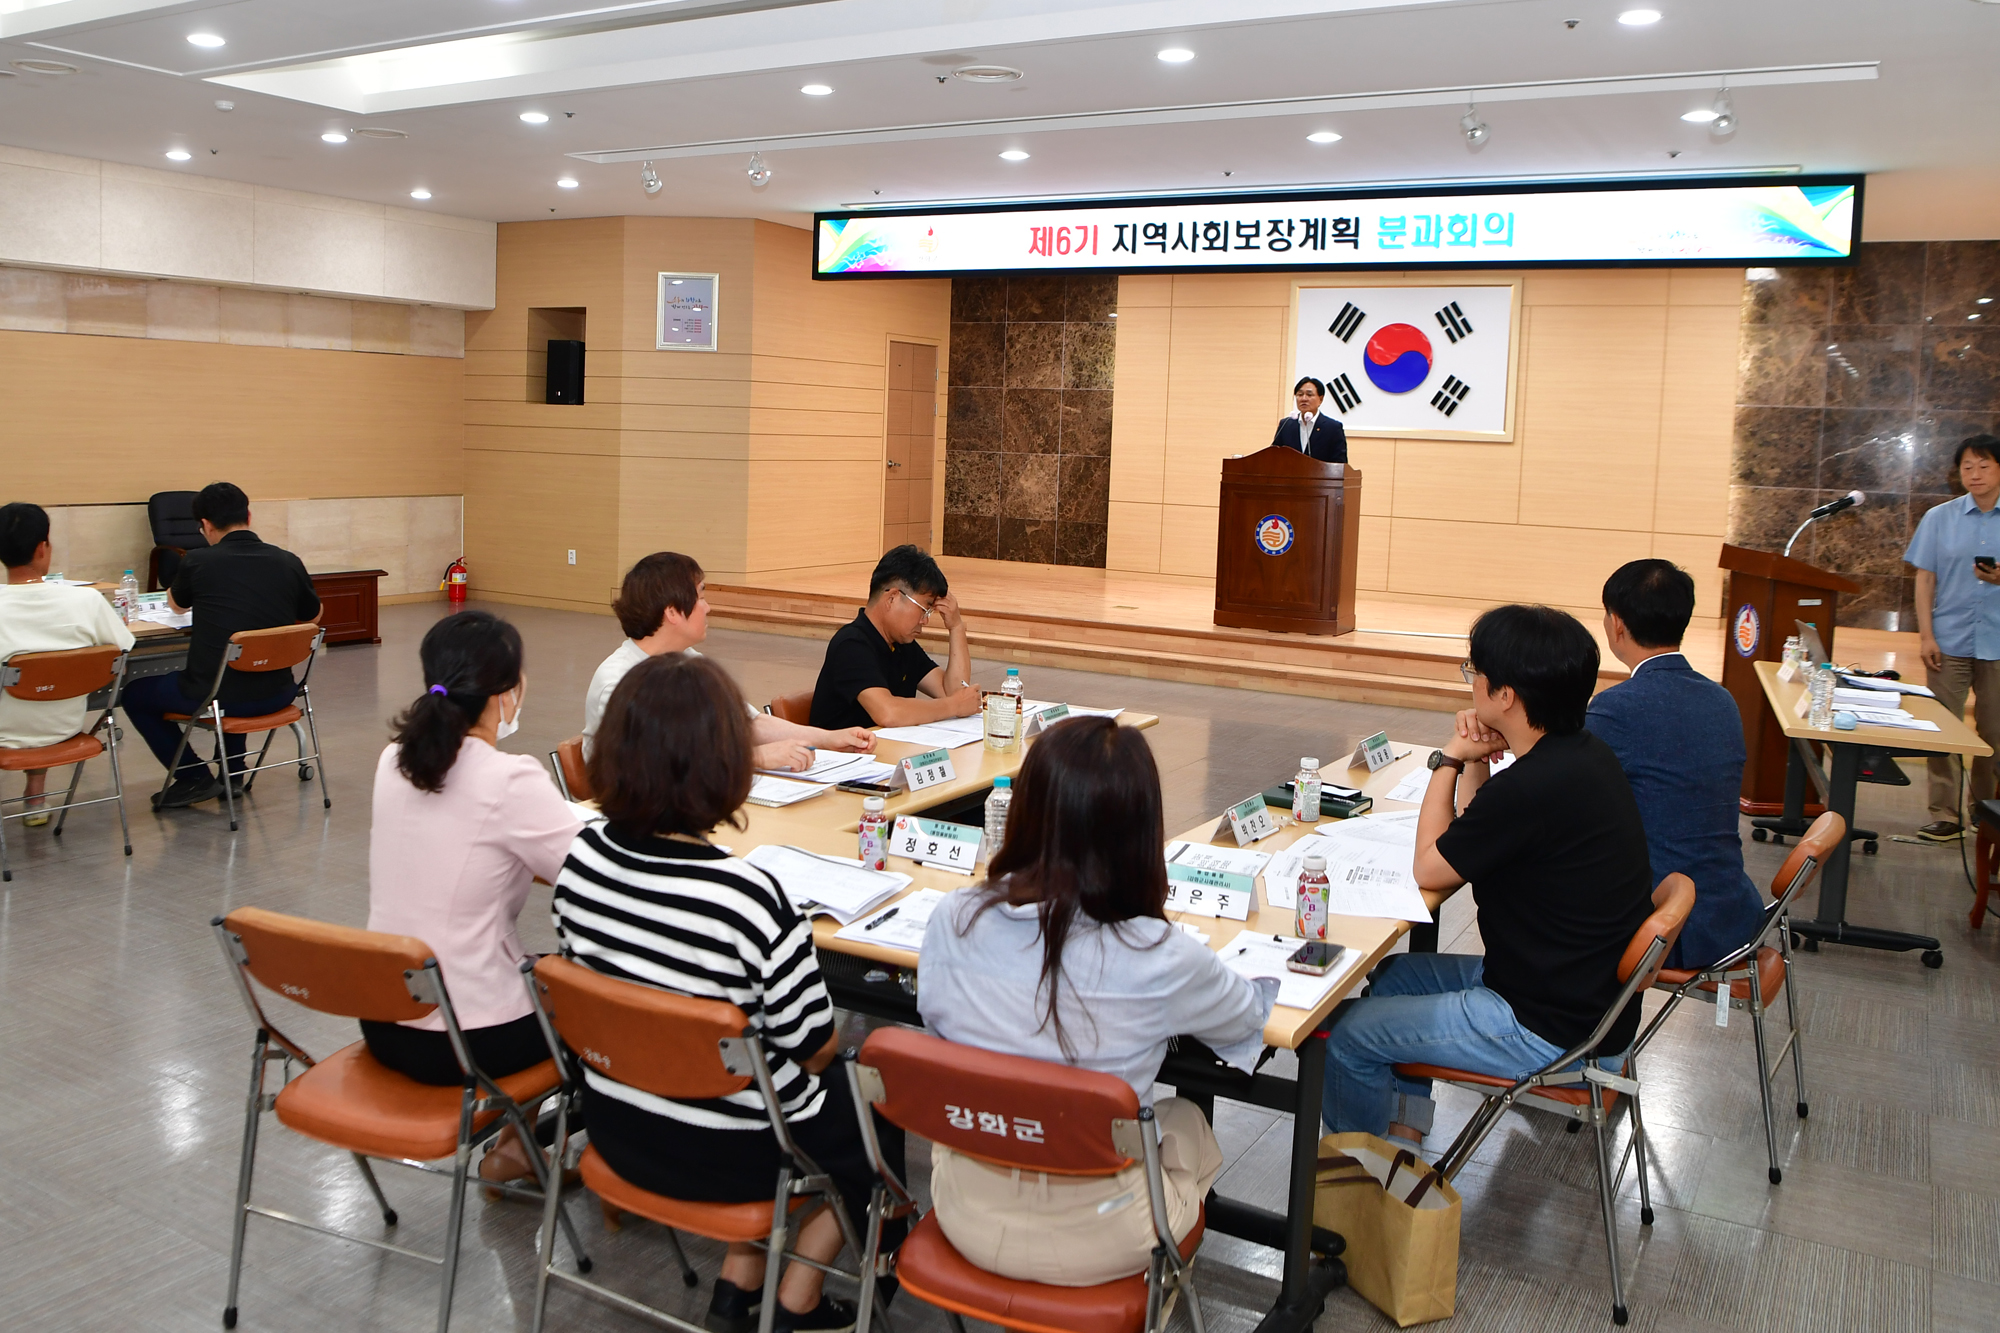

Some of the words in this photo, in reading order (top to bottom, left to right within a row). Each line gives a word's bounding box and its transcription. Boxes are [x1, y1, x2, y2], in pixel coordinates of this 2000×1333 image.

[1029, 225, 1098, 256] 제6기
[1111, 216, 1360, 254] 지역사회보장계획
[1377, 212, 1515, 250] 분과회의
[867, 840, 873, 848] B
[863, 848, 870, 856] C
[1303, 894, 1311, 903] A
[1309, 904, 1316, 912] B
[1304, 913, 1312, 921] C
[945, 1104, 1044, 1144] 강화군
